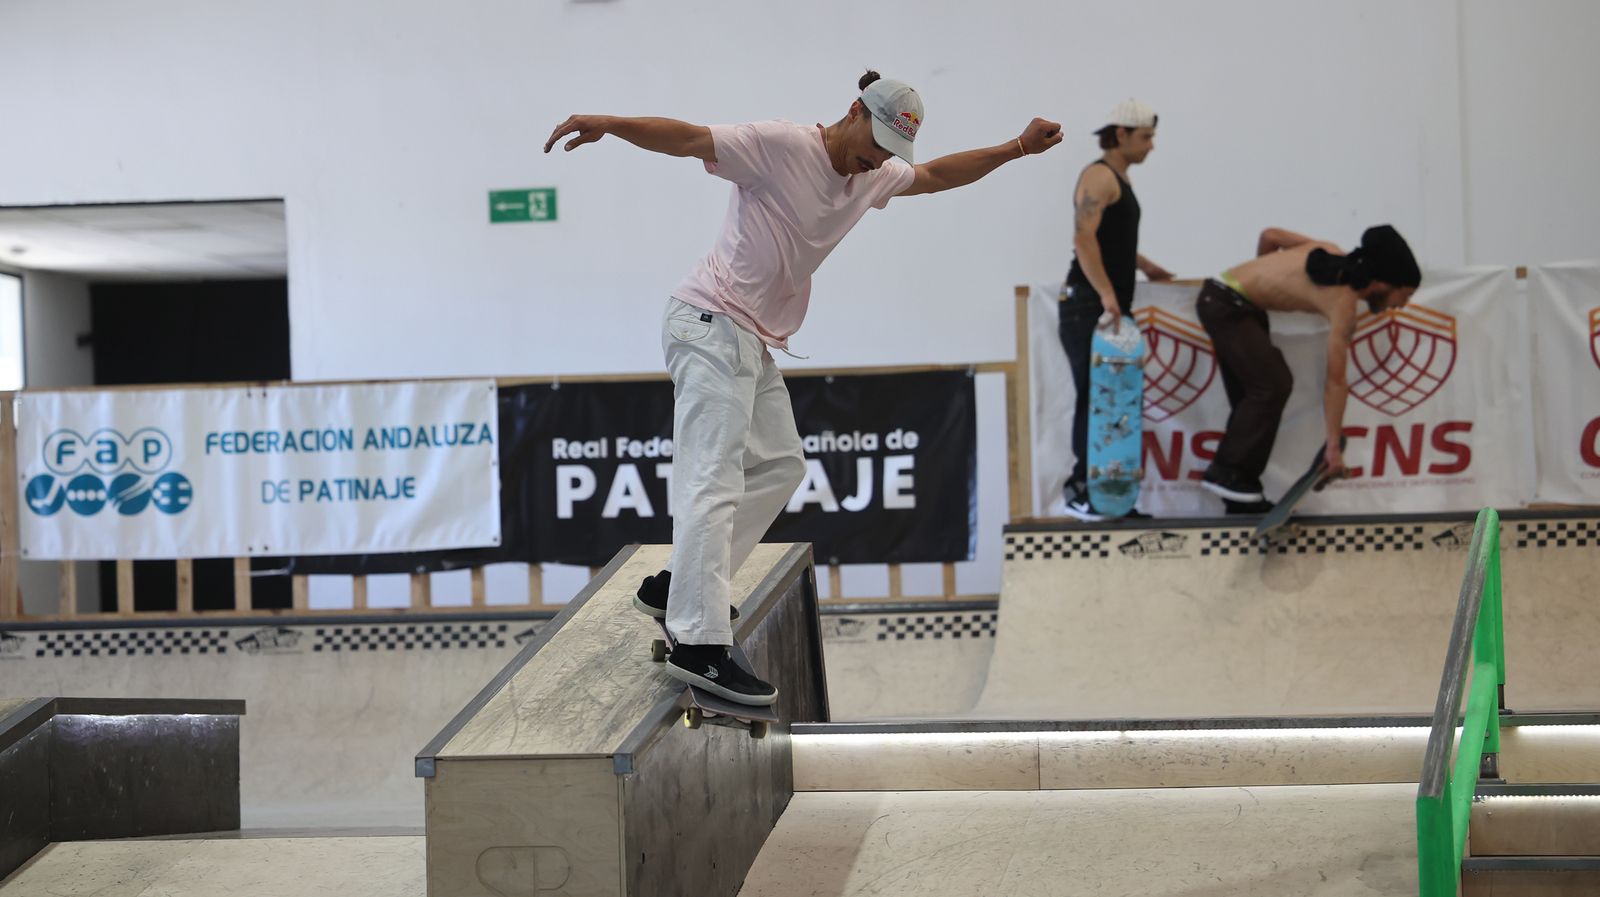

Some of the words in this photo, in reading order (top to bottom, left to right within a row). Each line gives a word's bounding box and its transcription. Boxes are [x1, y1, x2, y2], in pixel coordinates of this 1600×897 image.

[893, 118, 909, 133] Red
[205, 425, 353, 455] FEDERACIÓN
[363, 423, 493, 450] ANDALUZA
[552, 436, 608, 459] Real
[885, 428, 919, 450] de
[261, 480, 291, 504] DE
[299, 477, 416, 502] PATINAJE
